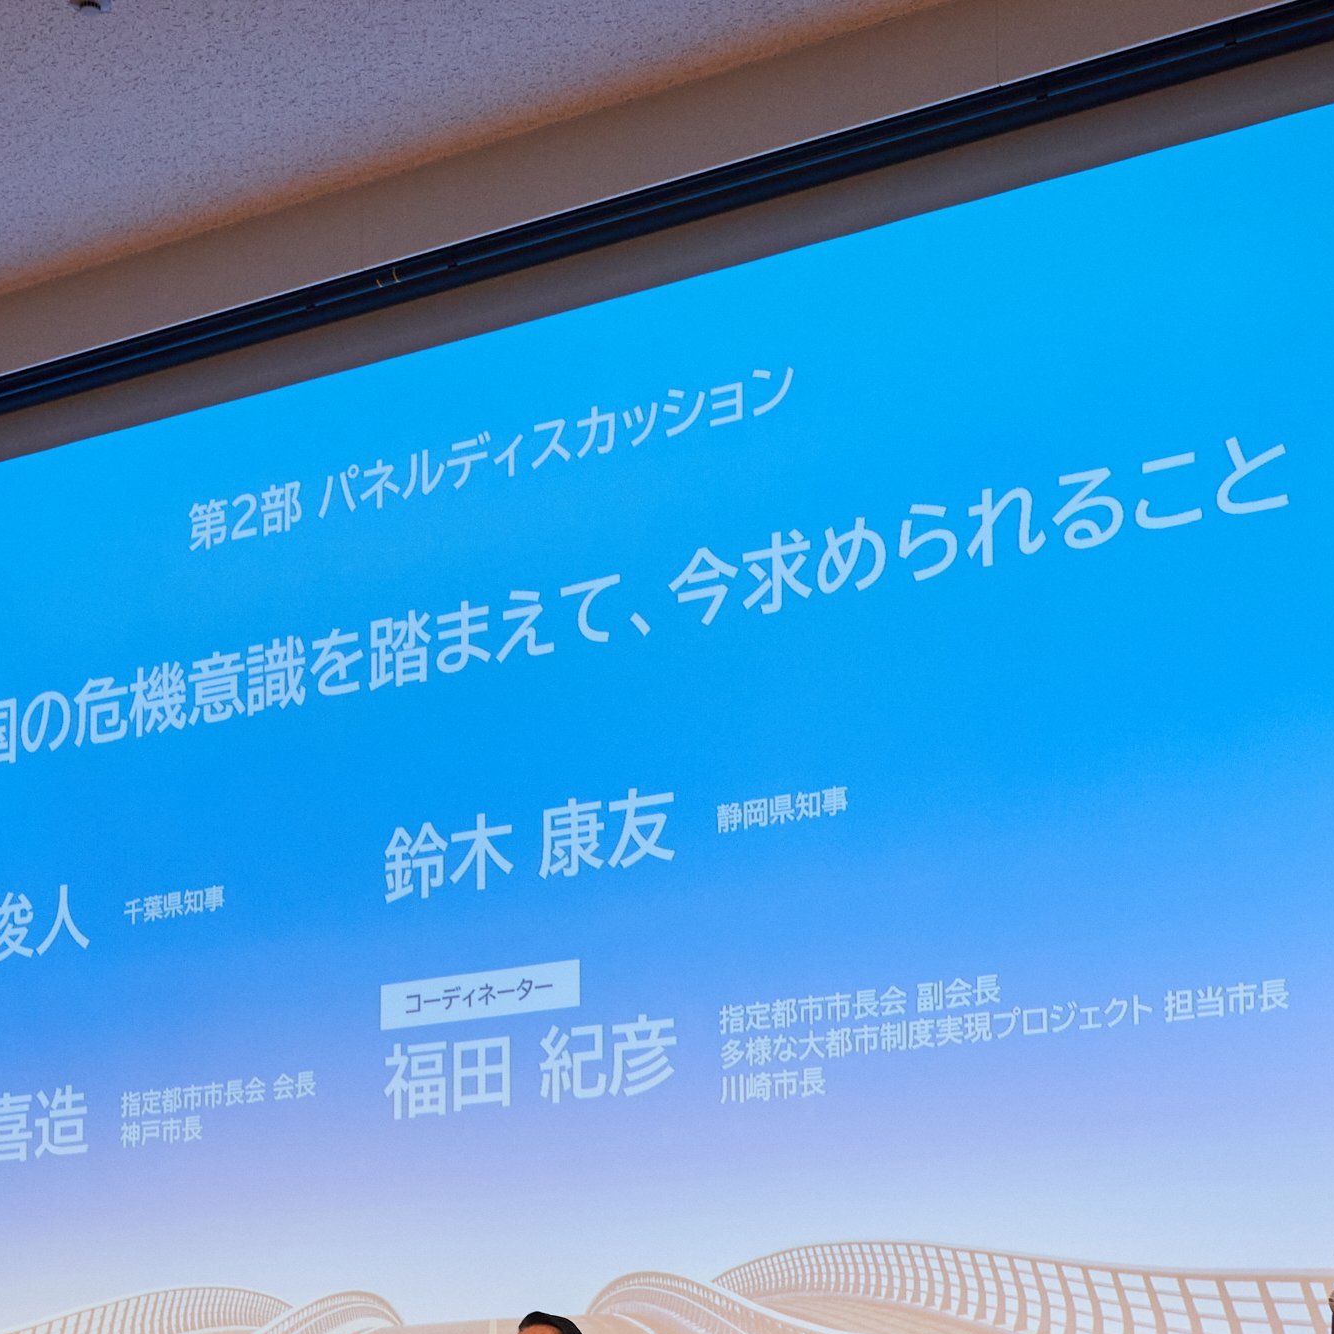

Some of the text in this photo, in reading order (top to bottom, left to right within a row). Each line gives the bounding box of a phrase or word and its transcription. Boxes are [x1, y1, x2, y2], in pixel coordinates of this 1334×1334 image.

[188, 366, 793, 551] 第2部 パネルディスカッション
[716, 786, 848, 834] 静岡県知事
[384, 788, 675, 904] 鈴木 康友
[123, 886, 225, 925] 千葉県知事
[405, 978, 554, 1014] コーディネーター
[719, 974, 1001, 1035] 指定都市市長会 副会長
[720, 978, 1289, 1069] 多様な大都市制度実現プロジェクト 担当市長
[384, 1014, 677, 1120] 福田 紀彦
[720, 1066, 827, 1104] 川崎市長
[120, 1071, 316, 1118] 指定都市市長会 会長
[120, 1115, 203, 1148] 神戸市長
